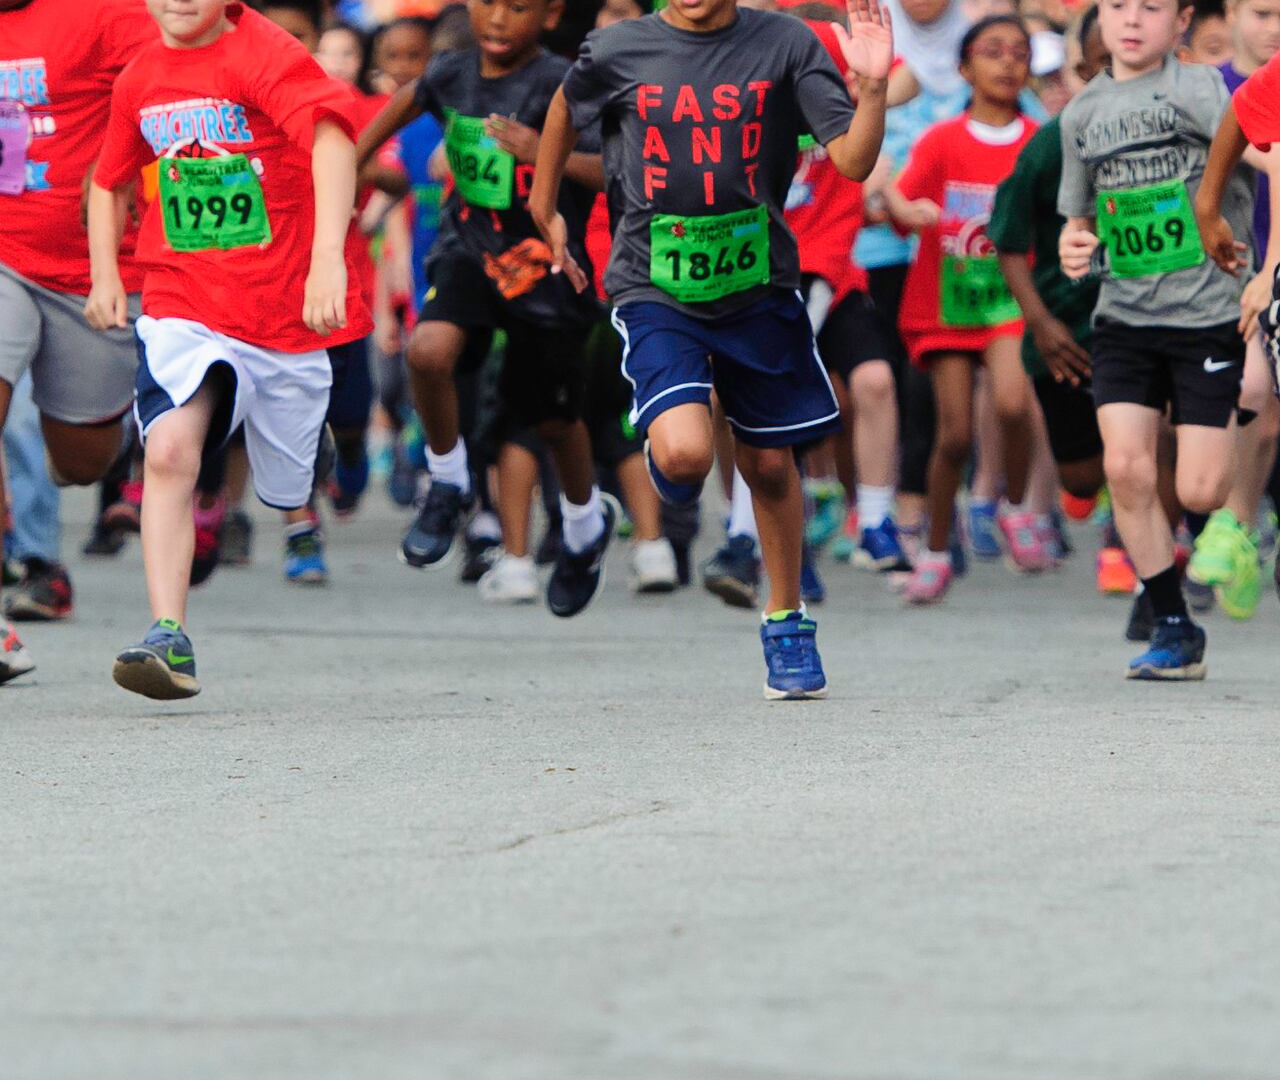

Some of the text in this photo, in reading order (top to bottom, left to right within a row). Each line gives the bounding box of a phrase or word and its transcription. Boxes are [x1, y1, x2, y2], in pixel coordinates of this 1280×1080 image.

[637, 80, 773, 122] FAST
[642, 122, 762, 164] AND
[643, 163, 759, 205] FIT
[167, 193, 252, 229] 1999
[1111, 218, 1184, 257] 2069
[665, 241, 757, 281] 1846
